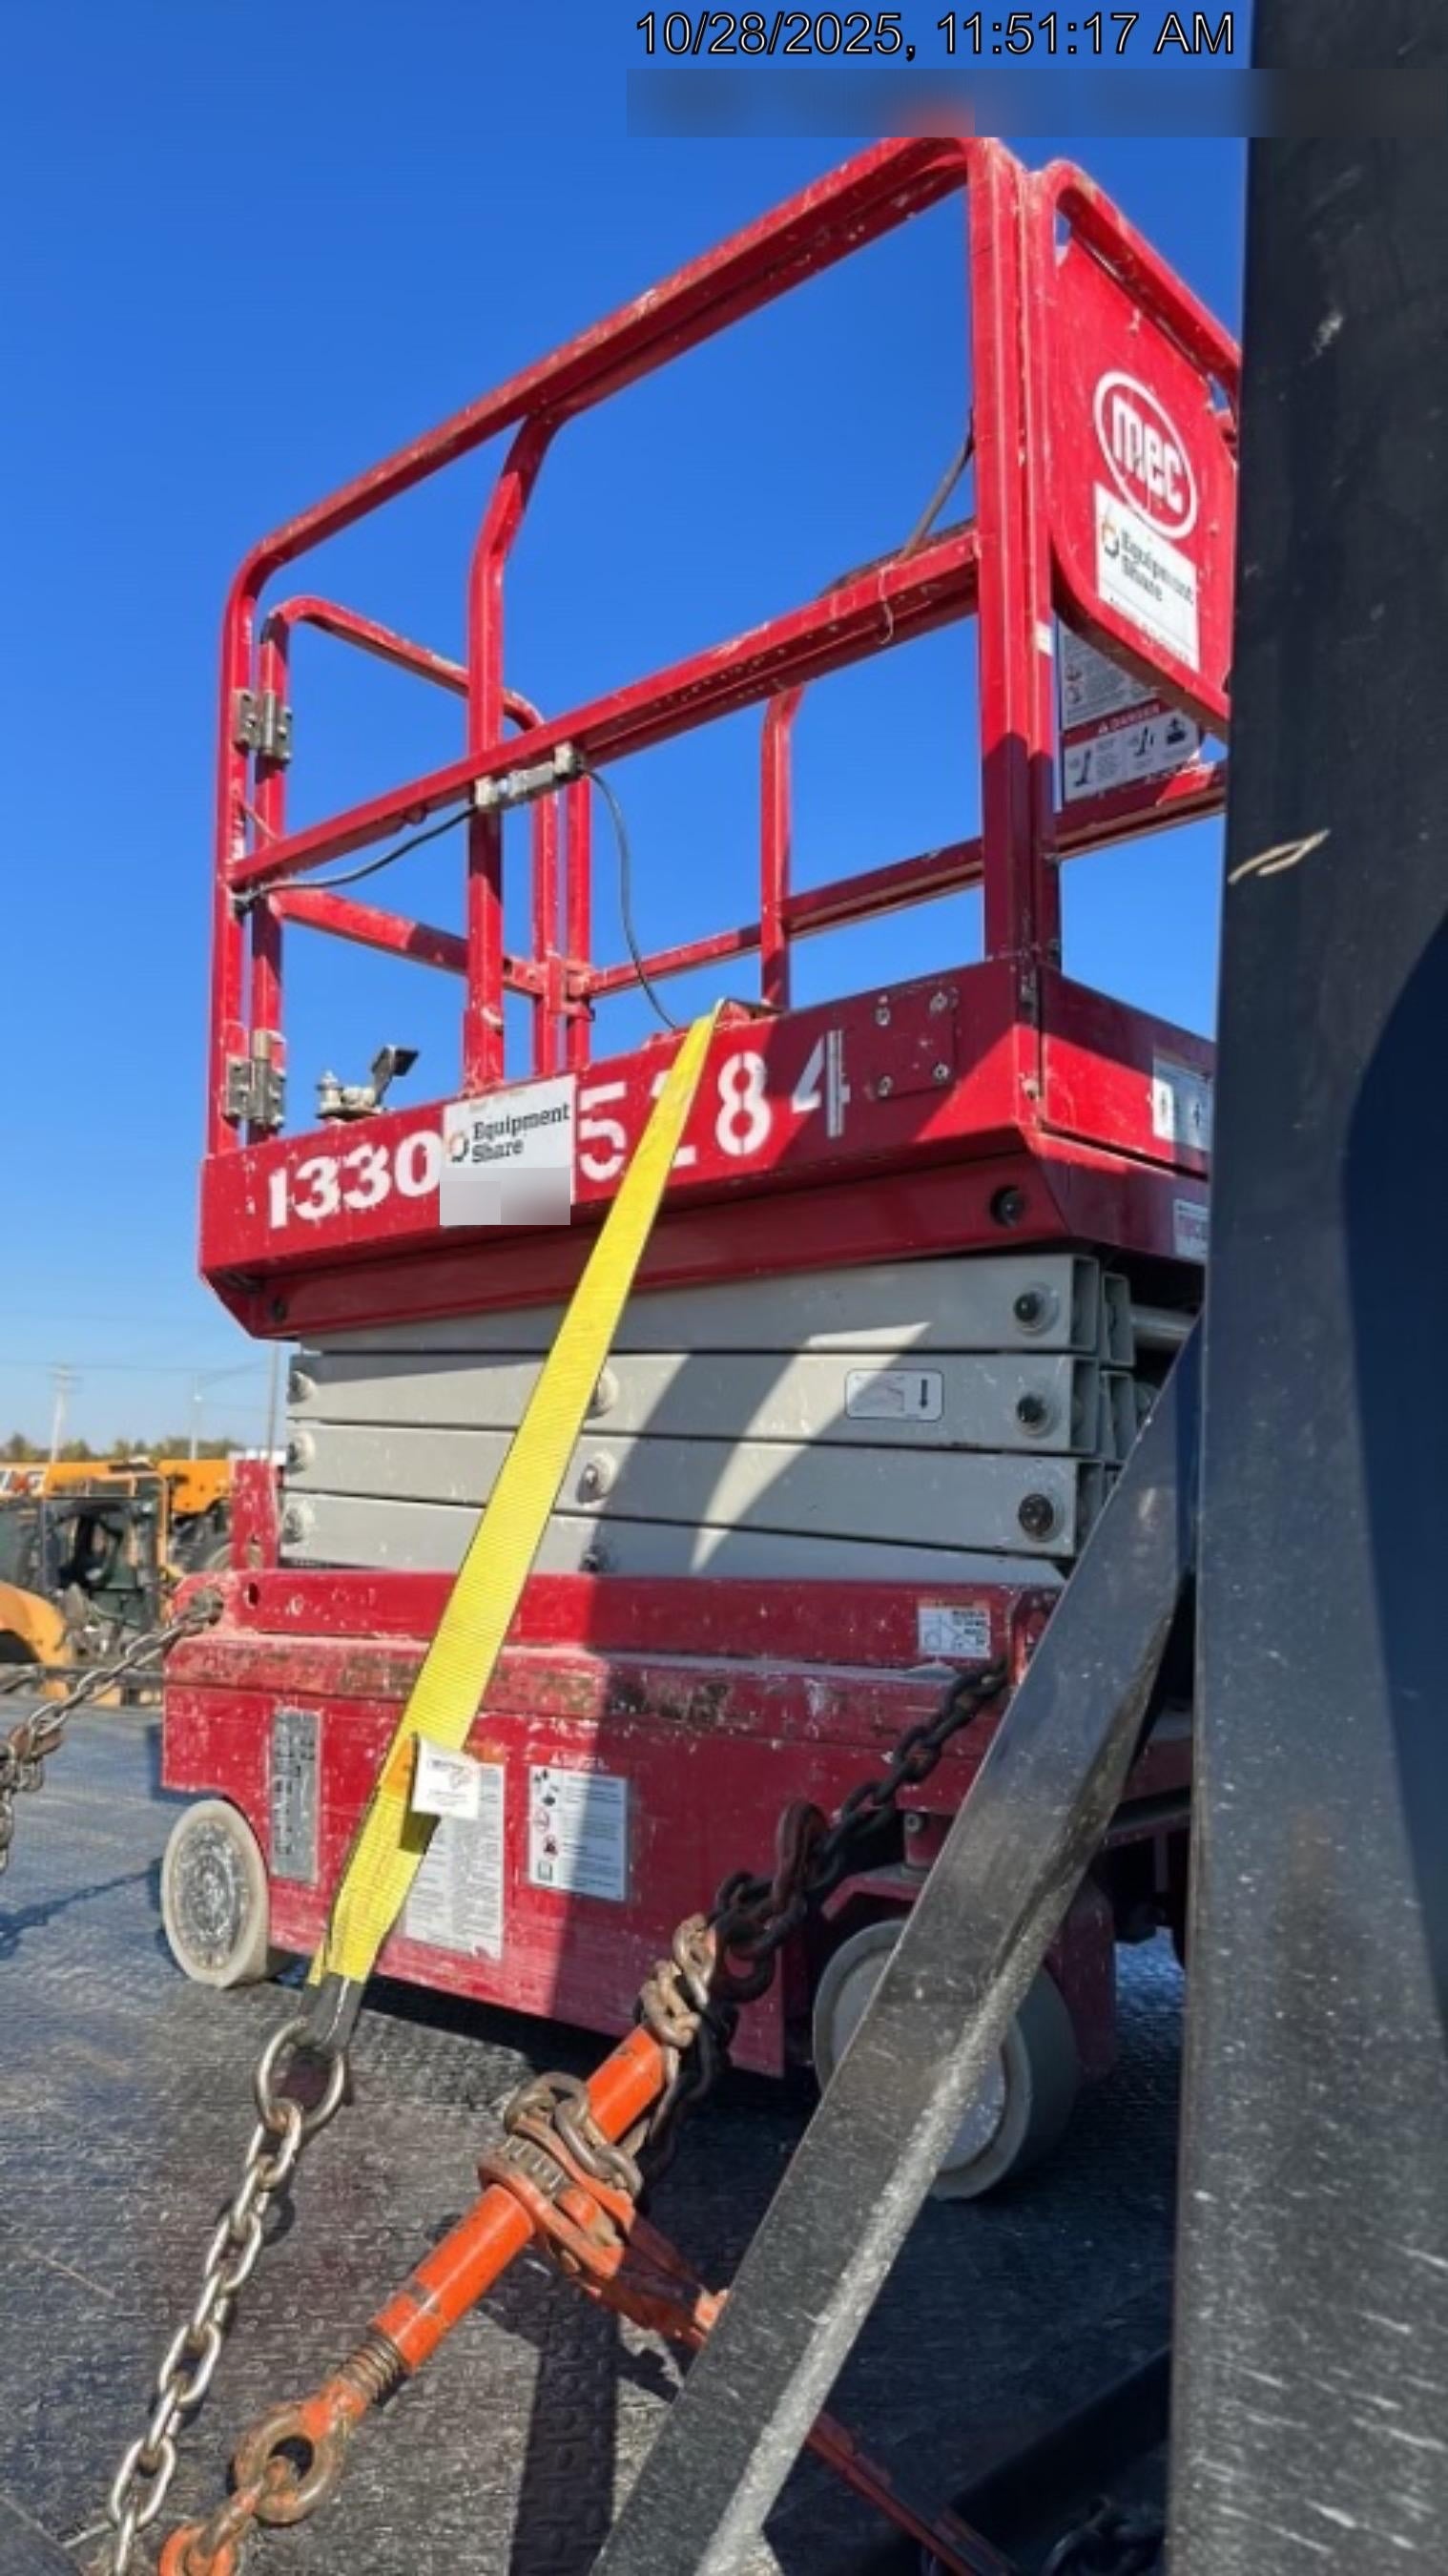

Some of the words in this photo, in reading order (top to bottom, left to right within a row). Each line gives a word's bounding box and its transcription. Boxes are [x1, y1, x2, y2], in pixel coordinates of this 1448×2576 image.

[472, 1101, 571, 1142] Equipment
[471, 1138, 525, 1164] Share
[268, 1130, 446, 1230] 1330
